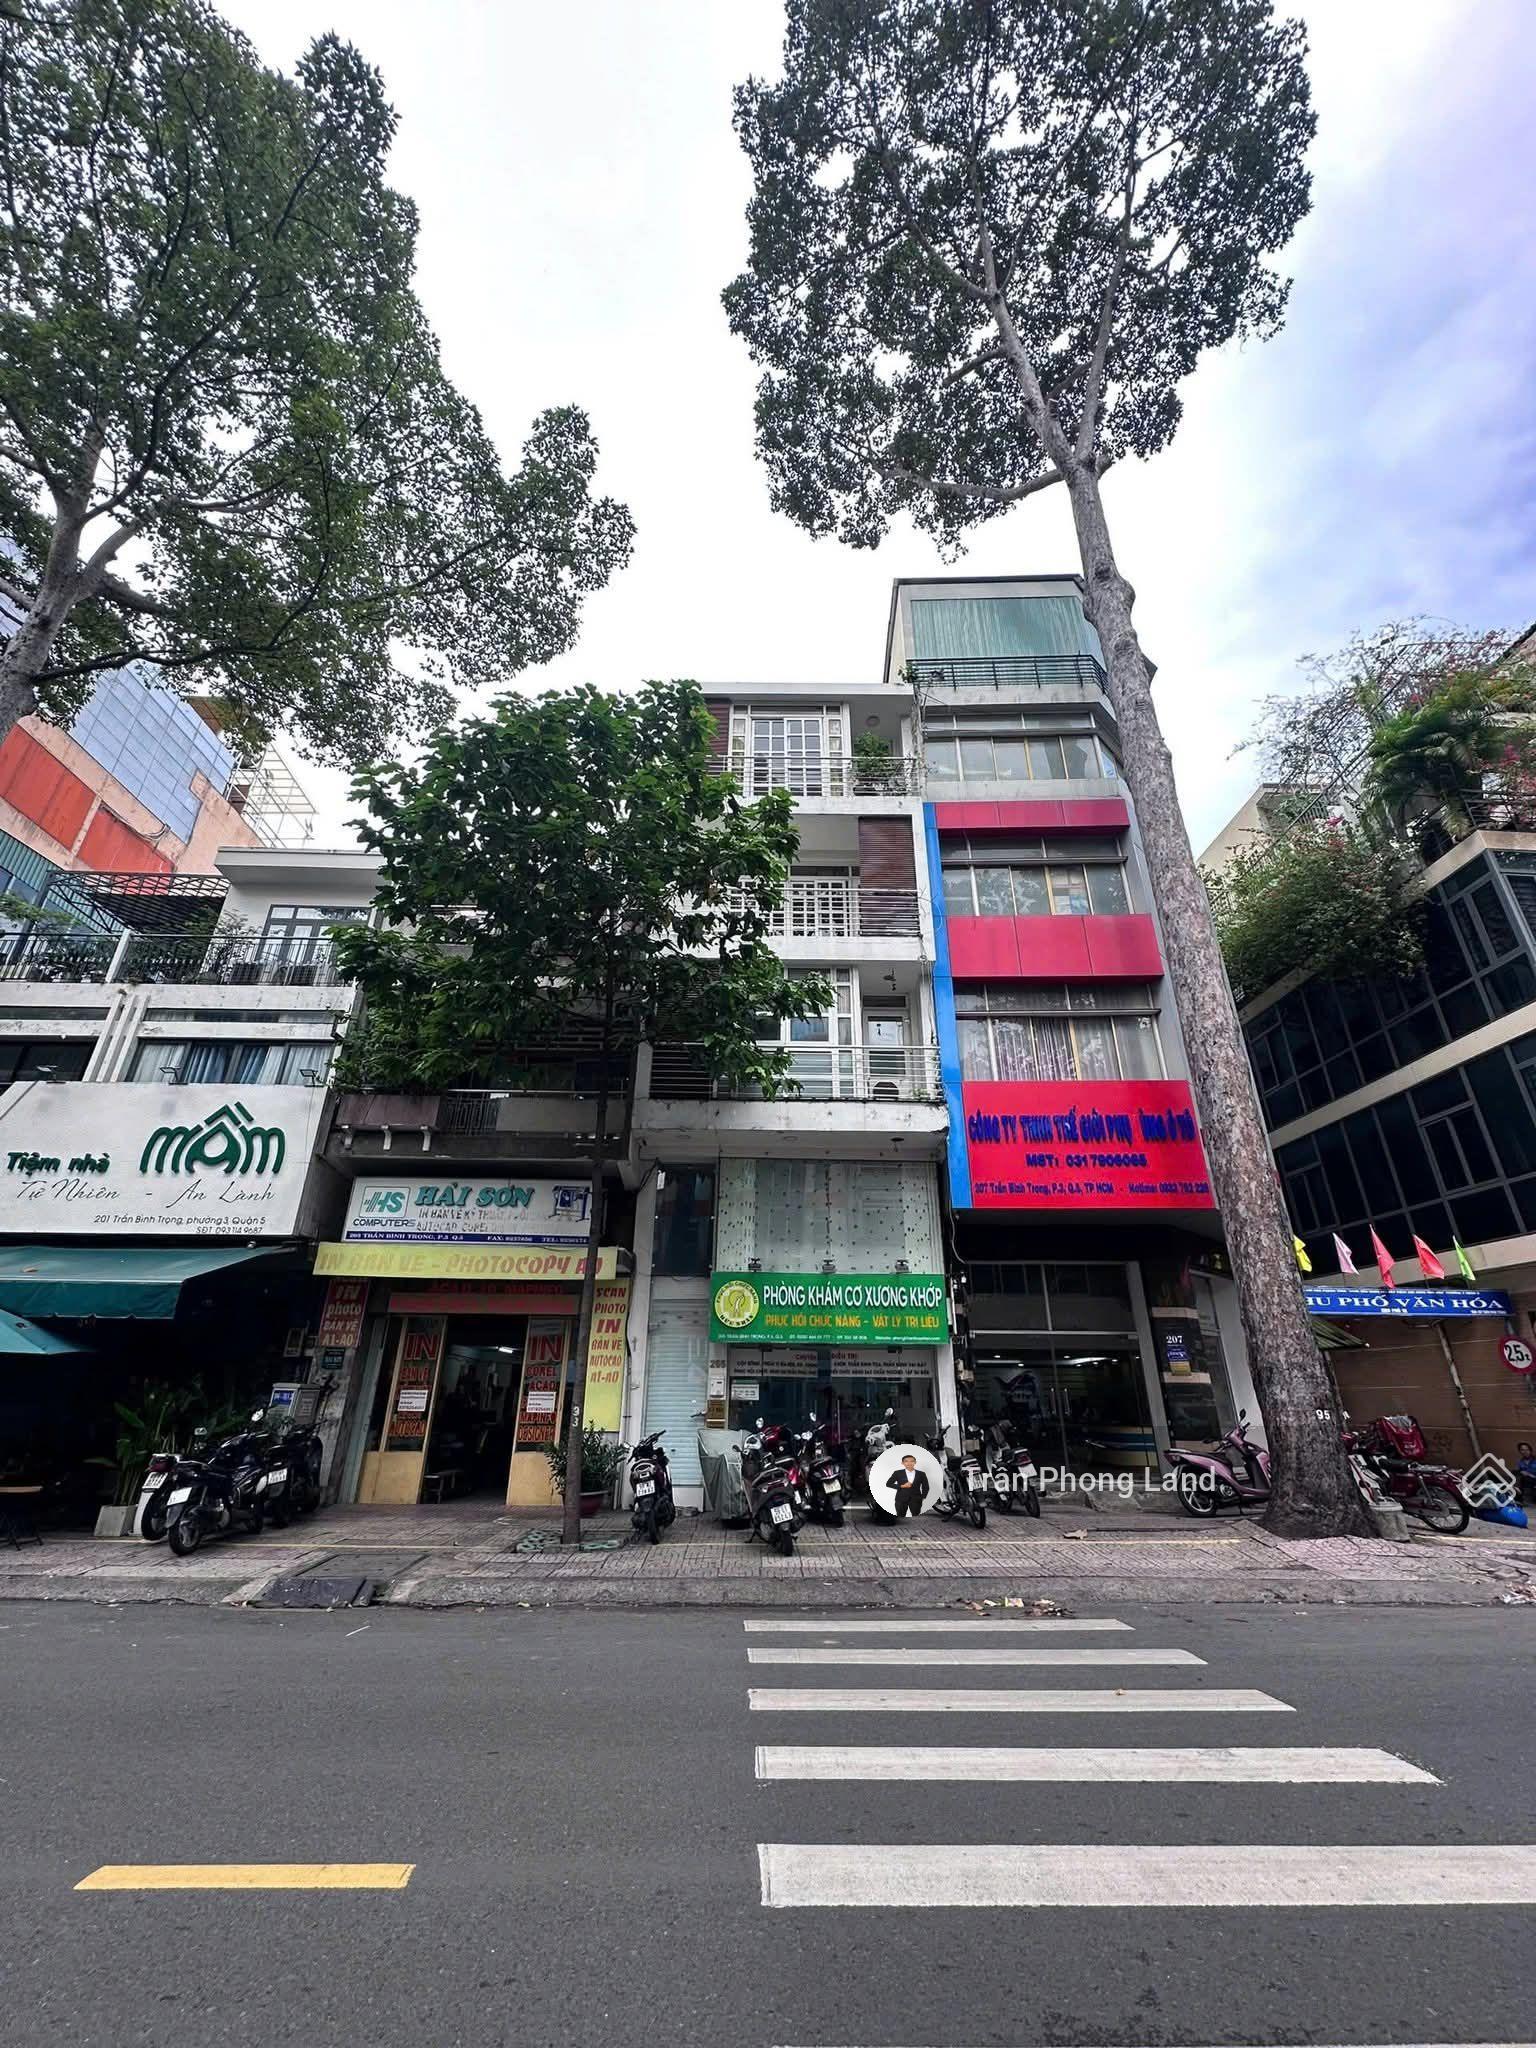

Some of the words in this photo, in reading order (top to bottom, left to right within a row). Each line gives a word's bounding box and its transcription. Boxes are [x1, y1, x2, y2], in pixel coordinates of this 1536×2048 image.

[1001, 1115, 1016, 1143] TY
[8, 1152, 60, 1177] Tiệm
[68, 1153, 110, 1173] nhà
[17, 1180, 46, 1200] Tự
[51, 1178, 120, 1201] Nhiên
[166, 1178, 206, 1208] An
[219, 1180, 275, 1203] Lành
[416, 1182, 473, 1207] HẢI
[476, 1184, 536, 1208] SƠN
[94, 1215, 110, 1224] 201
[353, 1218, 416, 1228] COMPUTERS
[446, 1254, 572, 1274] PHOTOCOPY
[596, 1287, 626, 1298] SCAN
[763, 1280, 806, 1306] PHÒNG
[808, 1281, 843, 1306] KHÁM
[845, 1286, 863, 1306] CƠ
[865, 1286, 908, 1307] XƯƠNG
[910, 1282, 942, 1307] KHỚP
[1339, 1294, 1389, 1308] PHỐ
[1396, 1296, 1450, 1309] VĂN
[1452, 1297, 1504, 1309] HÓA
[326, 1301, 362, 1319] photo
[594, 1303, 626, 1314] PHOTO
[596, 1318, 621, 1333] IN
[404, 1333, 438, 1361] IN
[528, 1335, 562, 1361] IN
[1166, 1335, 1182, 1344] 207
[1315, 1409, 1330, 1420] 95
